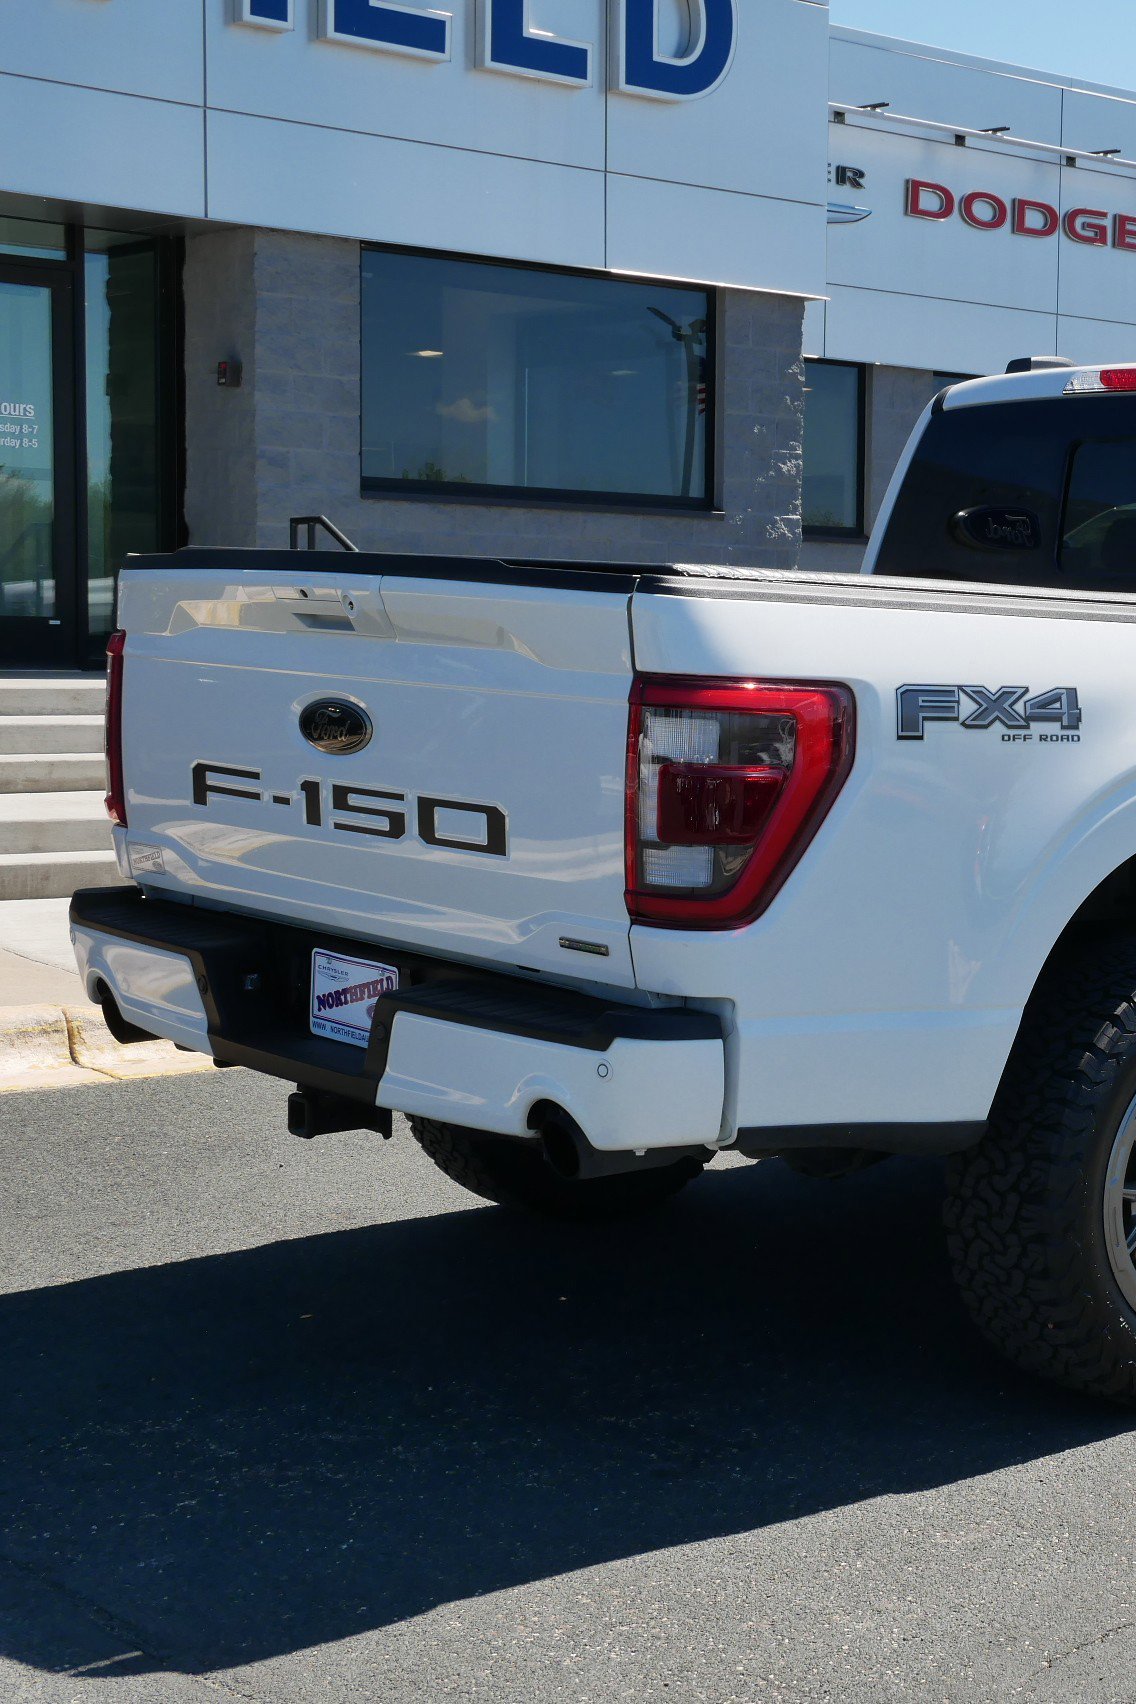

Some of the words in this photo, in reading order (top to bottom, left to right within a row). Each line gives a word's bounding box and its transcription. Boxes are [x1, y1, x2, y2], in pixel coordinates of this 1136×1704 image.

[233, 0, 739, 103] LD
[827, 162, 865, 189] R
[22, 424, 38, 434] 8-7
[22, 438, 38, 448] 8-5
[311, 709, 352, 742] Ford
[896, 684, 1082, 740] FX4
[1001, 733, 1033, 743] OFF
[1039, 733, 1081, 743] ROAD
[191, 760, 508, 857] F-150
[317, 964, 349, 977] CHRYSLER
[316, 975, 394, 1012] NORTHFIELD
